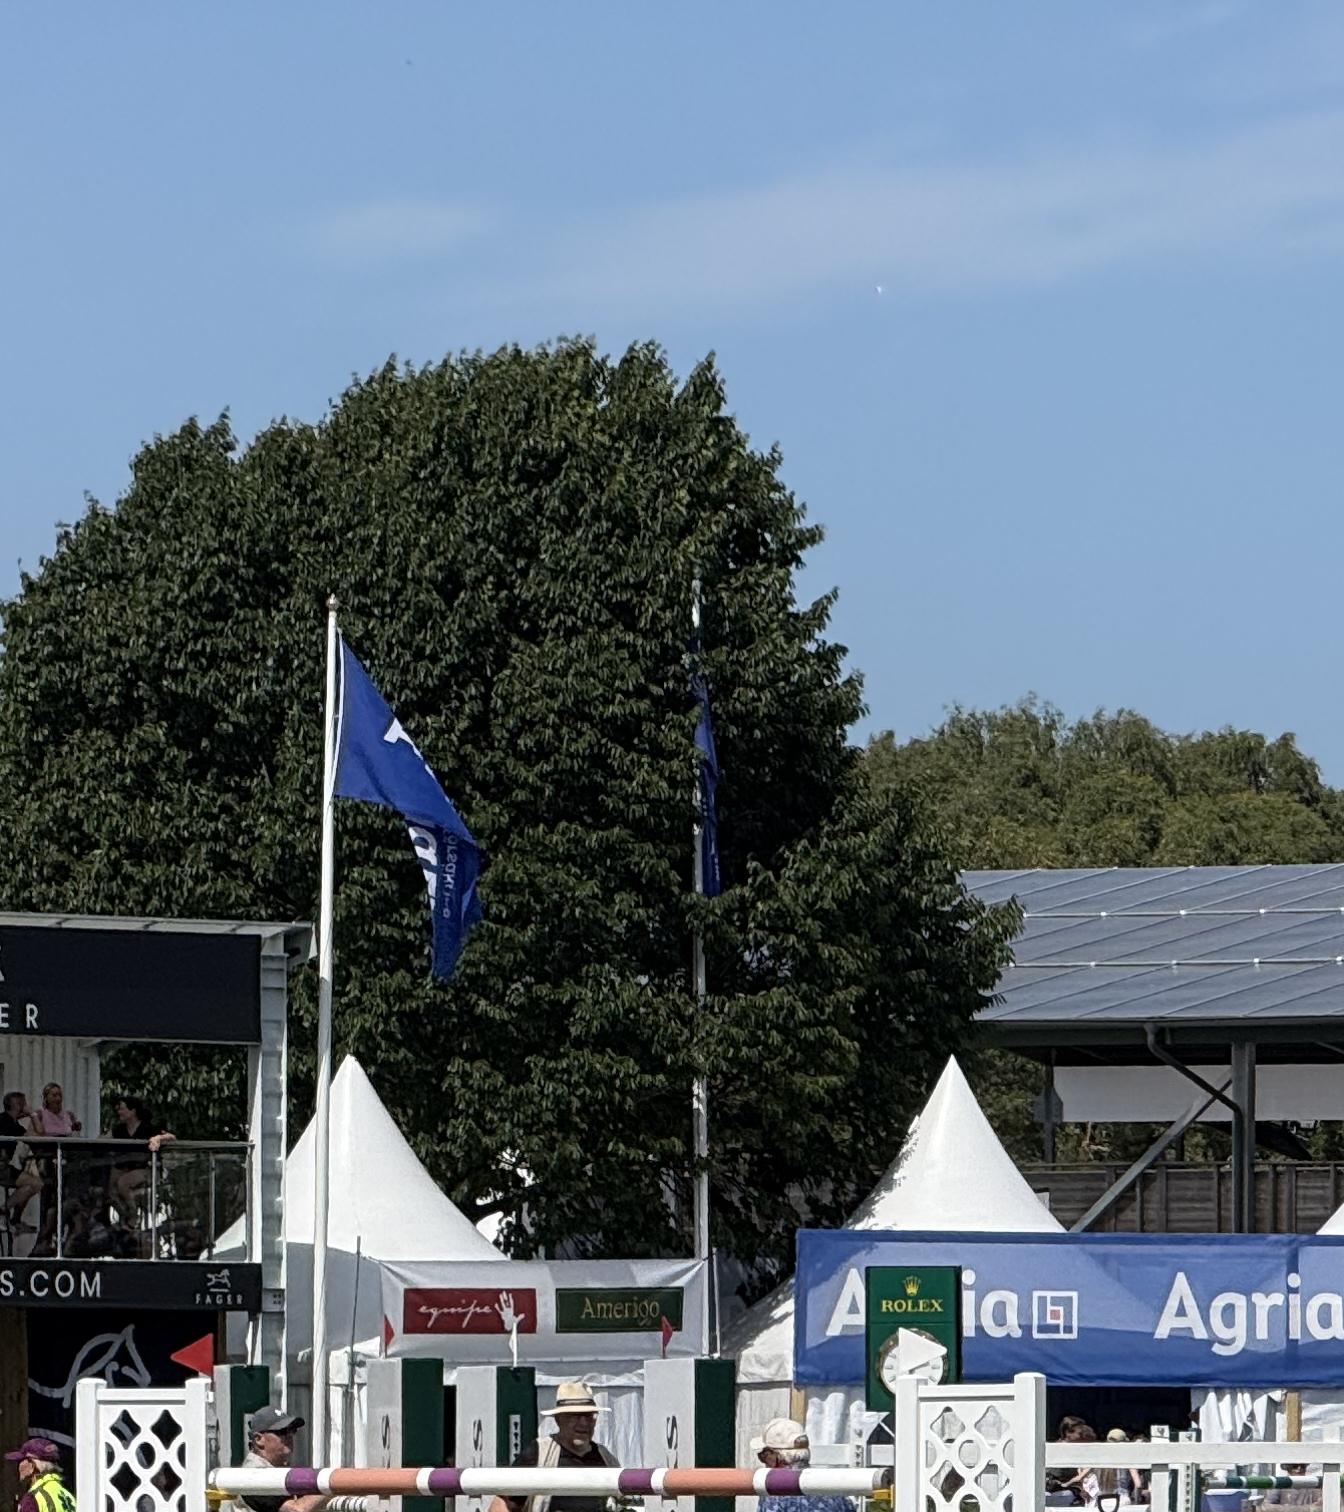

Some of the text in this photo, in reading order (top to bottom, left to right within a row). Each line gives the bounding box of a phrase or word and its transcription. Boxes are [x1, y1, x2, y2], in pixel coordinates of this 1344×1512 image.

[0, 1270, 101, 1298] S.COM
[195, 1294, 243, 1305] FAGER
[581, 1297, 660, 1326] Amerigo
[825, 1267, 1022, 1338] Aia
[881, 1299, 944, 1313] ROLEX
